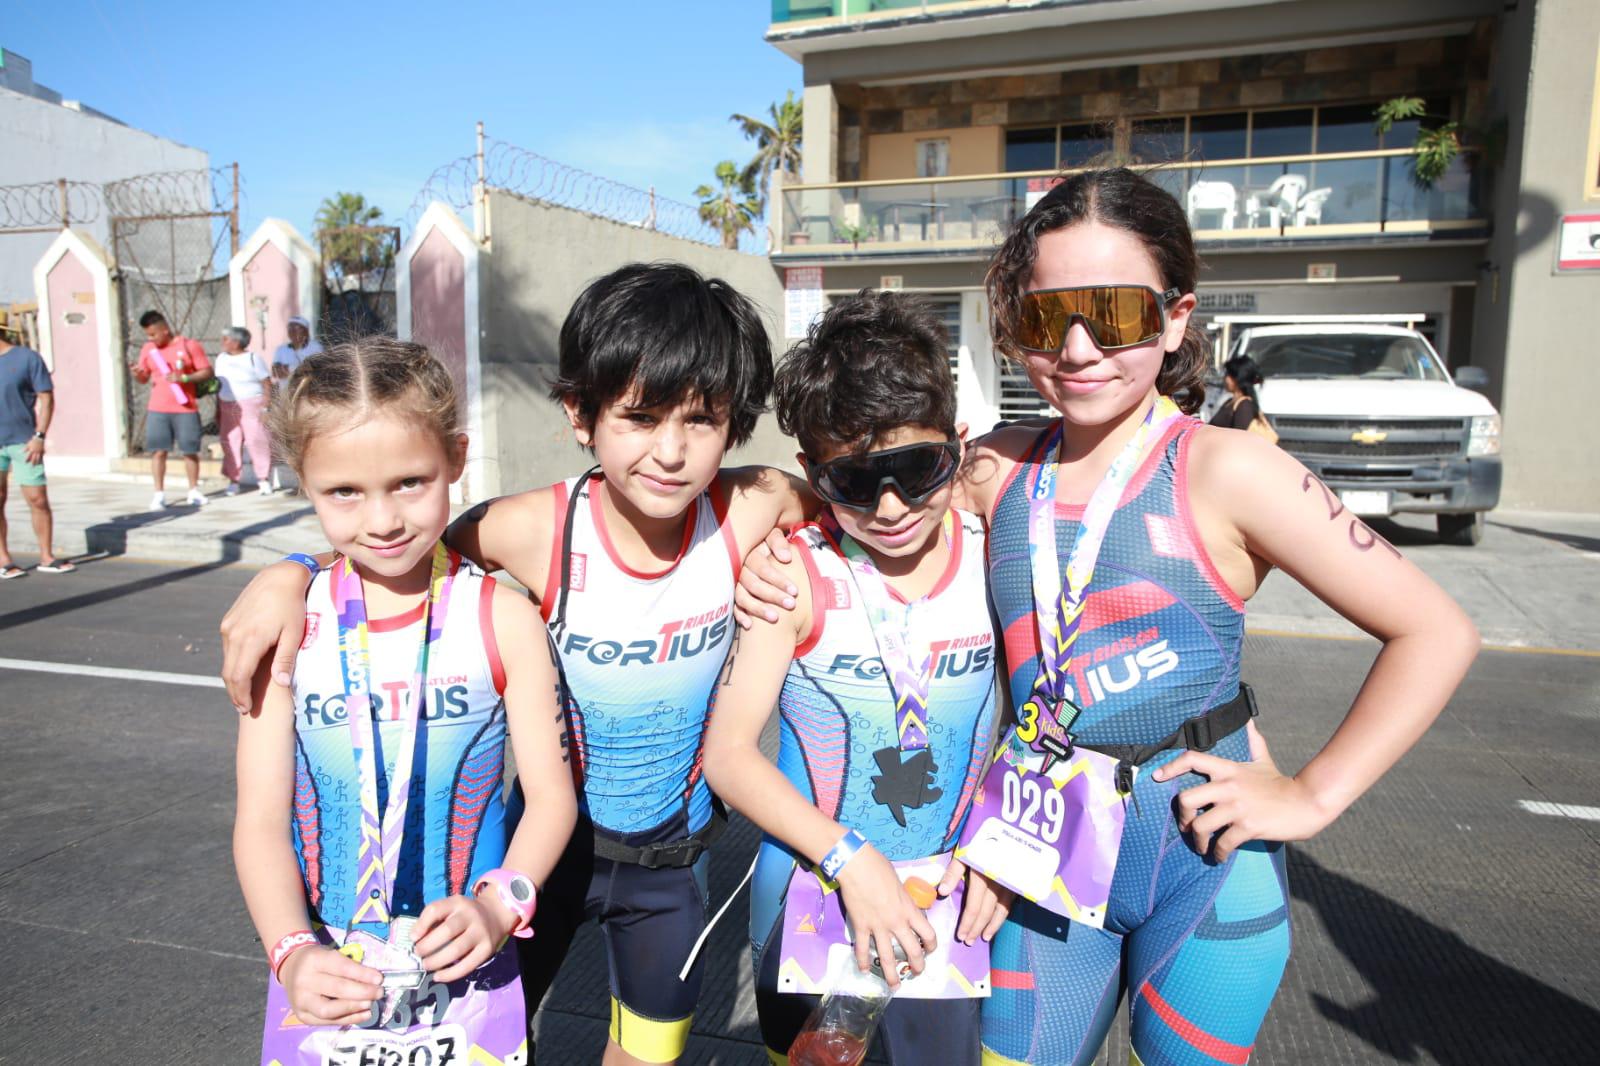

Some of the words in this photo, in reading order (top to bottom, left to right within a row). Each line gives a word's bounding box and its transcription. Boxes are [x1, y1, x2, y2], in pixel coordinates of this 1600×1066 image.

[1303, 472, 1402, 560] 29
[563, 616, 729, 667] FORTIUS
[827, 640, 992, 680] FOTIUS
[1016, 702, 1039, 742] 3
[1001, 770, 1065, 843] 029
